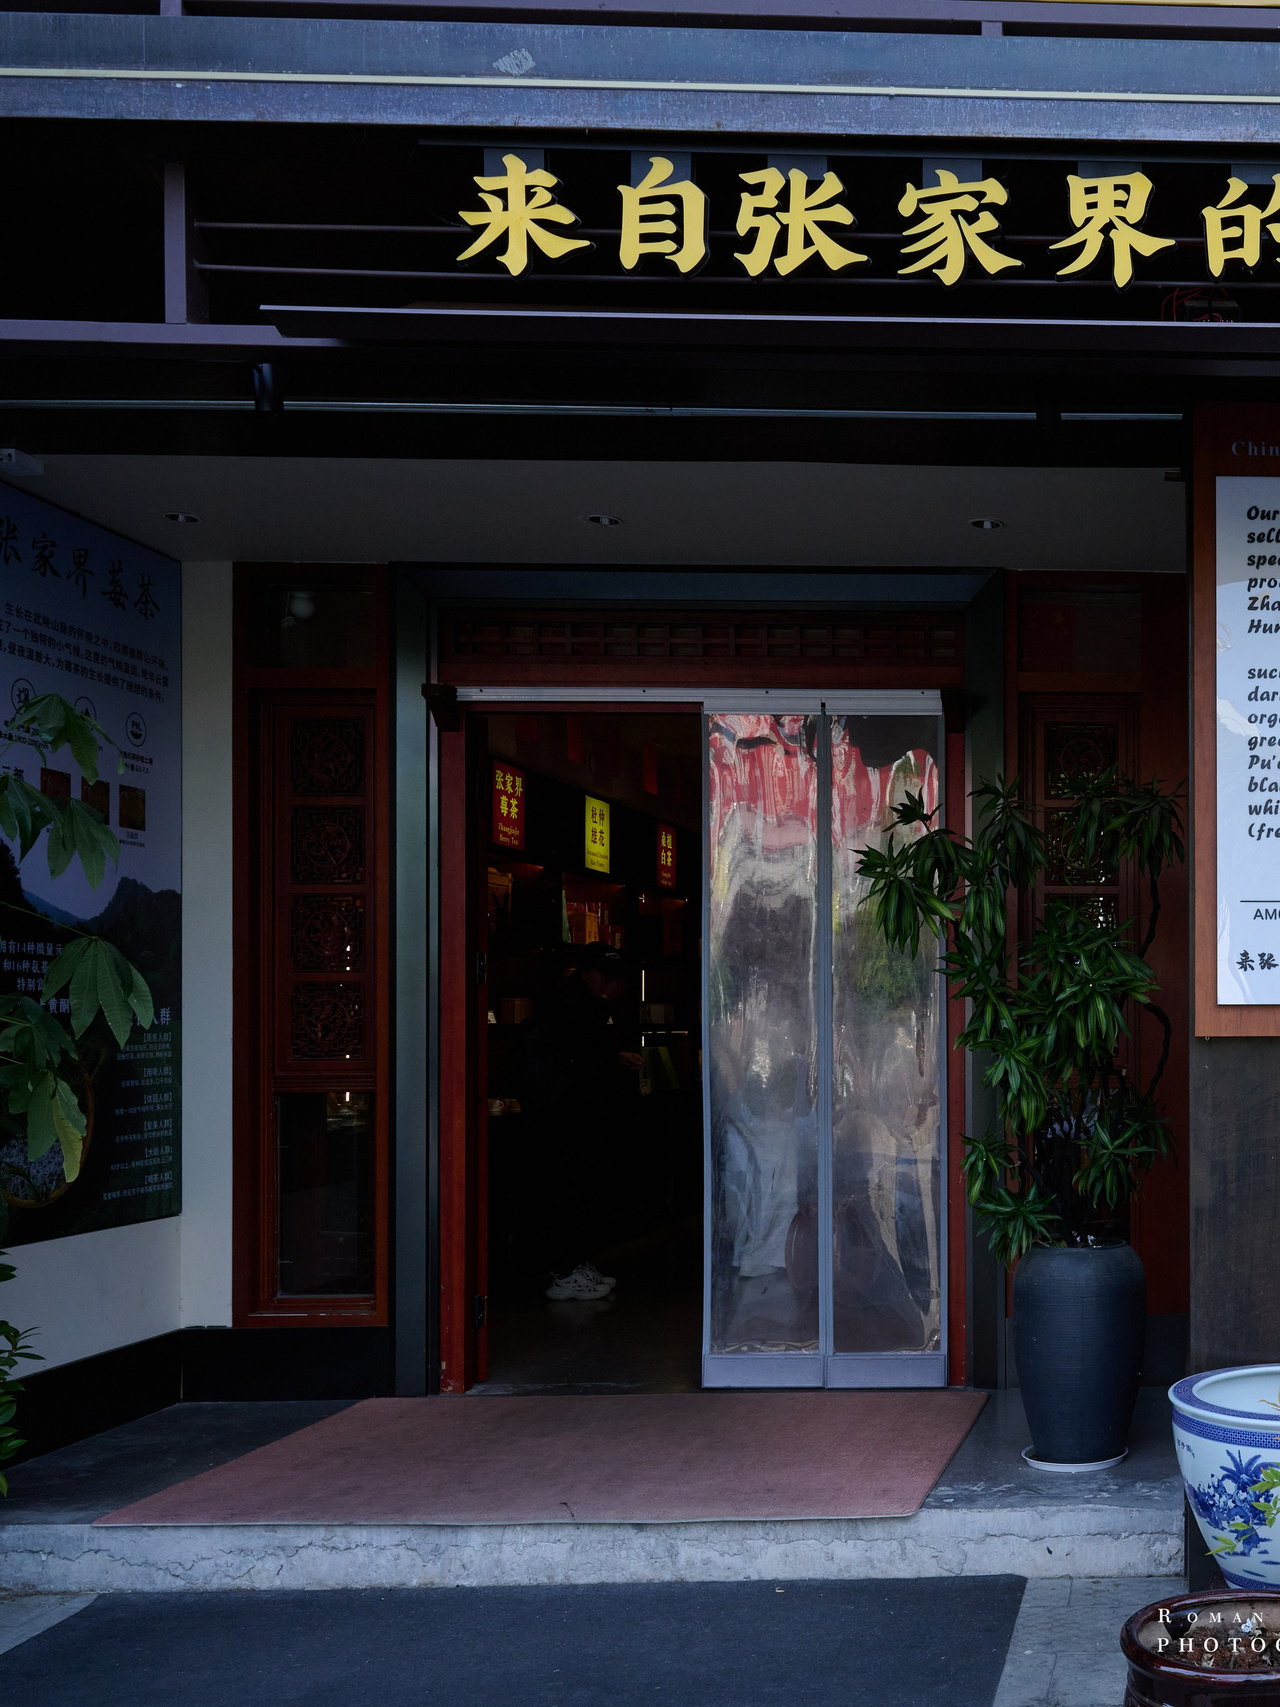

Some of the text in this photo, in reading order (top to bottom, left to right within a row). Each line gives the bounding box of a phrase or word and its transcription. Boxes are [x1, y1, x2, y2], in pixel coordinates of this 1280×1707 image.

[1246, 505, 1280, 521] Our
[495, 769, 523, 797] 张家界
[500, 795, 519, 819] 莓茶
[661, 849, 672, 867] 白茶
